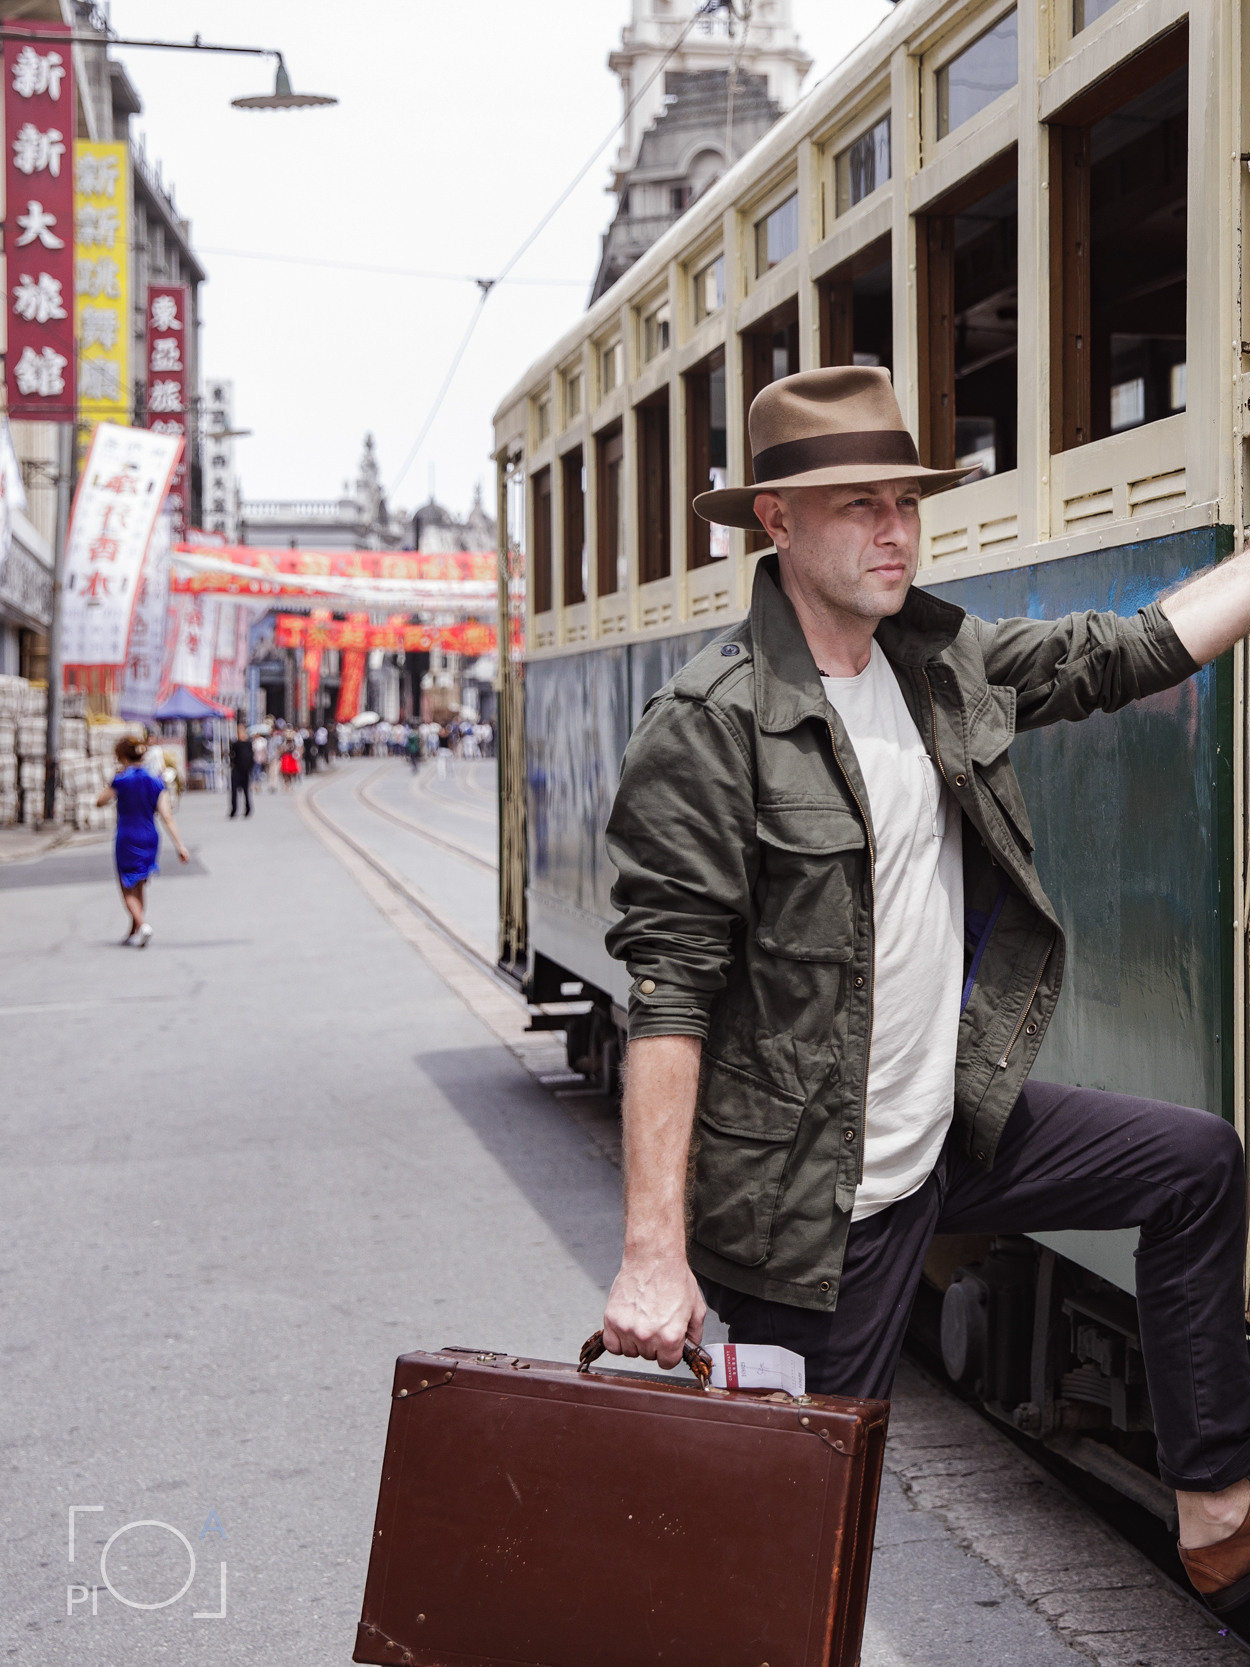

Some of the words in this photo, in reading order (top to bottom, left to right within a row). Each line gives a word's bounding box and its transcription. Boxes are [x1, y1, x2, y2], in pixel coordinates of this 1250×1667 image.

[11, 46, 66, 397] 新新大旅館
